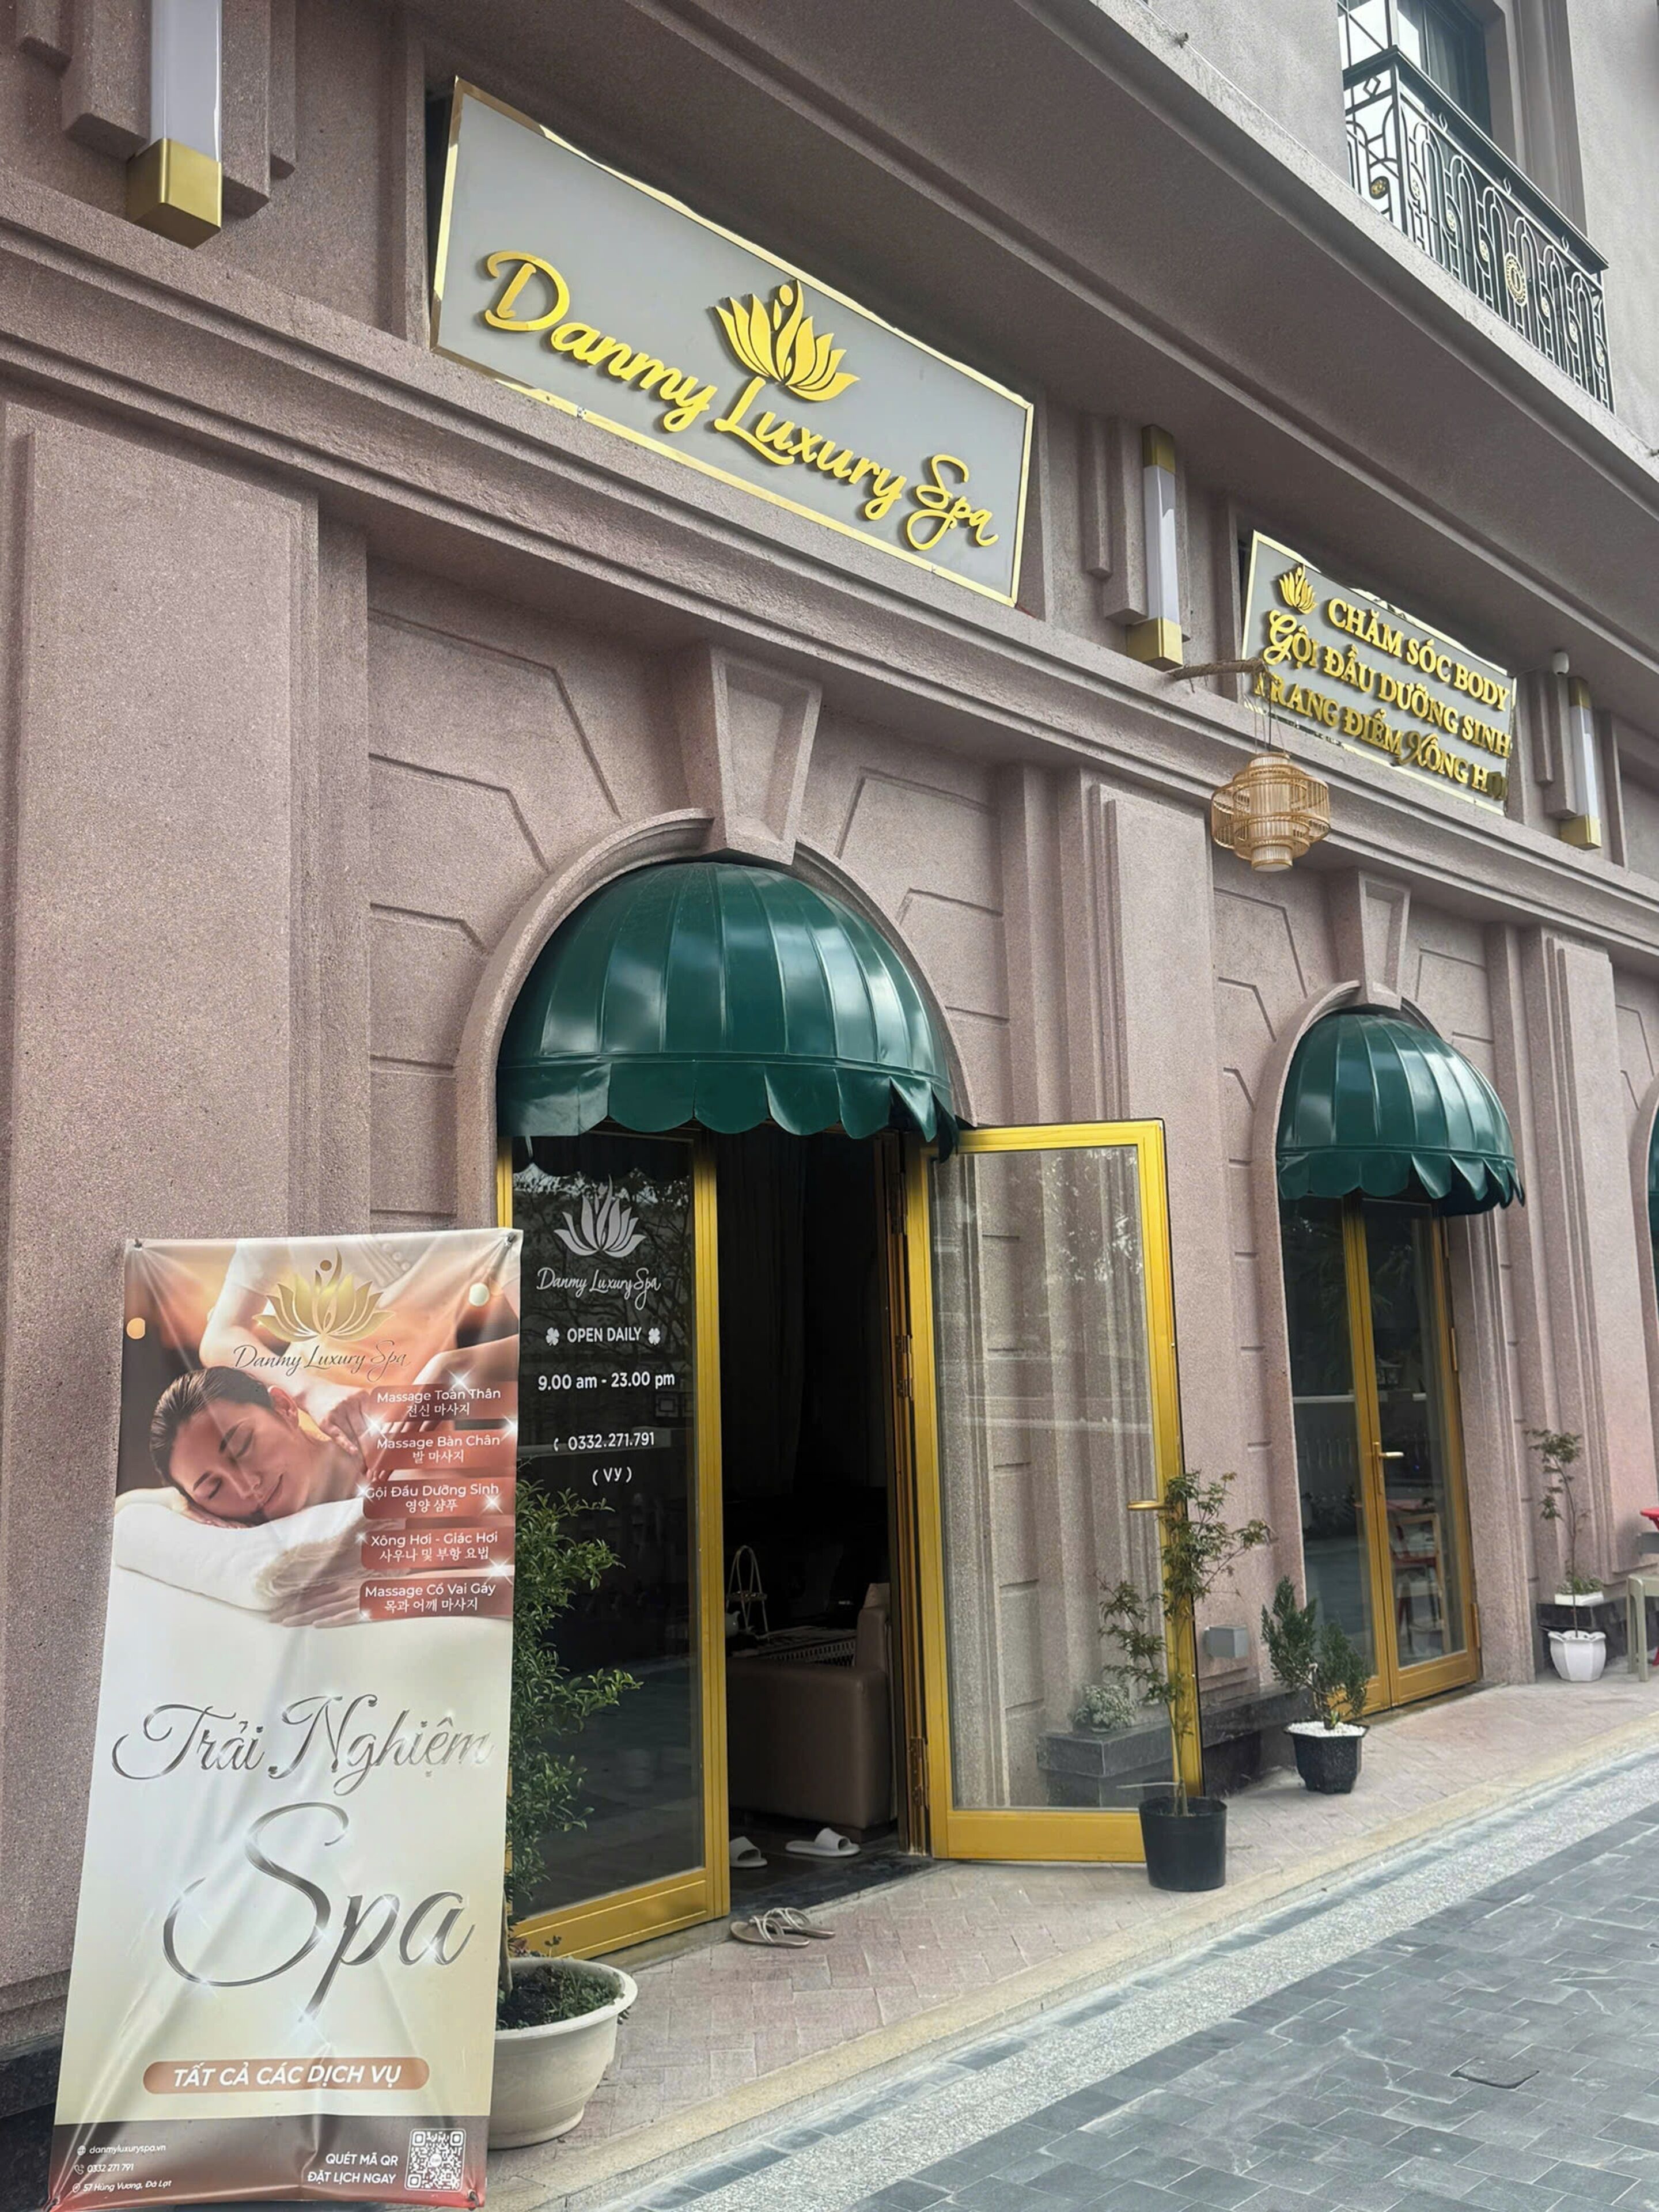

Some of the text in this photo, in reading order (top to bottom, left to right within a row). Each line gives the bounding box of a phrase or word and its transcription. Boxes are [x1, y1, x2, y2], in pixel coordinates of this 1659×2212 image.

[483, 250, 999, 551] Danmy Luxury Spa
[1328, 597, 1510, 711] CHĂM SÓC BODY
[1263, 609, 1512, 759] GỘI ĐẦU DƯỠNG SINH
[1343, 708, 1404, 756] ĐIỂM
[1397, 730, 1469, 785] XÔNG
[536, 1267, 661, 1310] Danmy Luxury Spa
[567, 1326, 642, 1343] OPEN DAILY
[233, 1339, 411, 1382] Danmy Luxury Spa
[538, 1374, 572, 1391] 9.00
[575, 1376, 598, 1389] am
[611, 1371, 650, 1387] 23.00
[654, 1373, 676, 1389] pm
[377, 1388, 501, 1403] Massage Toàn Thân
[407, 1402, 471, 1418] 전신 마사지
[377, 1434, 501, 1450] Massage Bàn Chân
[568, 1431, 655, 1450] 0332.271.791
[413, 1449, 464, 1464] 발 마사지
[422, 1484, 467, 1498] Dưỡng
[470, 1483, 499, 1495] Sinh
[406, 1498, 459, 1513] 영양 샴푸
[371, 1535, 406, 1548] Xông
[410, 1533, 432, 1546] Hơi
[444, 1532, 472, 1545] Giác
[476, 1531, 498, 1544] Hơi
[378, 1546, 490, 1563] 사우나 및 부항 요법
[365, 1586, 423, 1599] Massage
[448, 1582, 467, 1593] Vai
[470, 1581, 497, 1596] Gáy
[385, 1597, 479, 1613] 목과 어깨 마사지
[111, 1694, 499, 1796] Trải Nghiệm
[162, 1801, 475, 2023] Spa
[173, 2062, 403, 2089] TẤT CẢ CÁC DỊCH VỤ
[89, 2144, 166, 2155] danmyluxuryspa.vn
[325, 2151, 399, 2166] QUÉT MÃ QR
[87, 2163, 134, 2173] 0332 271 791
[308, 2169, 396, 2186] ĐẶT LỊCH NGAY
[83, 2183, 93, 2192] 57
